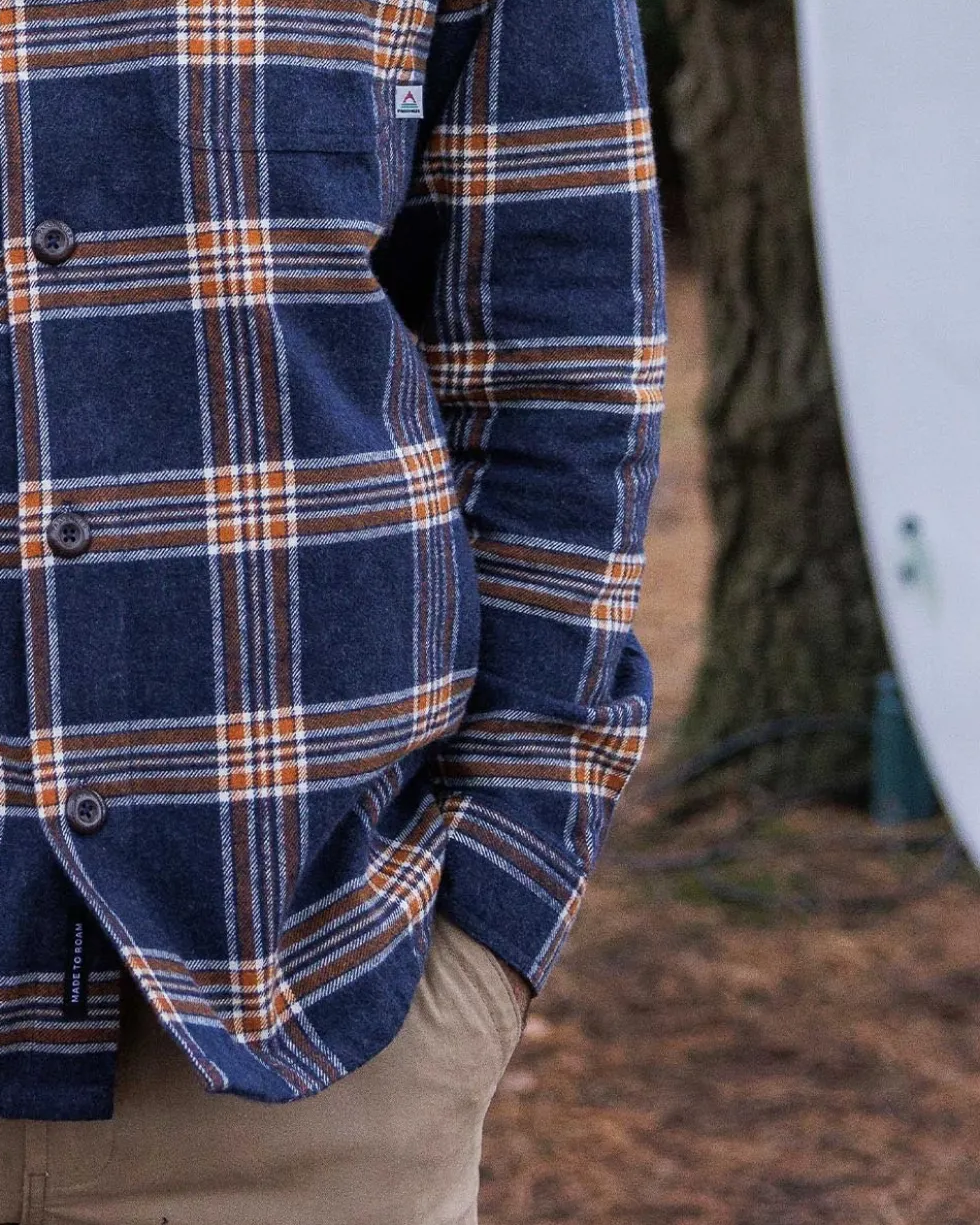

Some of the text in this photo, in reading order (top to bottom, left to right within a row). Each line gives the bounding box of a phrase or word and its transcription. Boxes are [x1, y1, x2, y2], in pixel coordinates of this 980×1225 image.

[71, 923, 83, 1003] MADE TO ROAM
